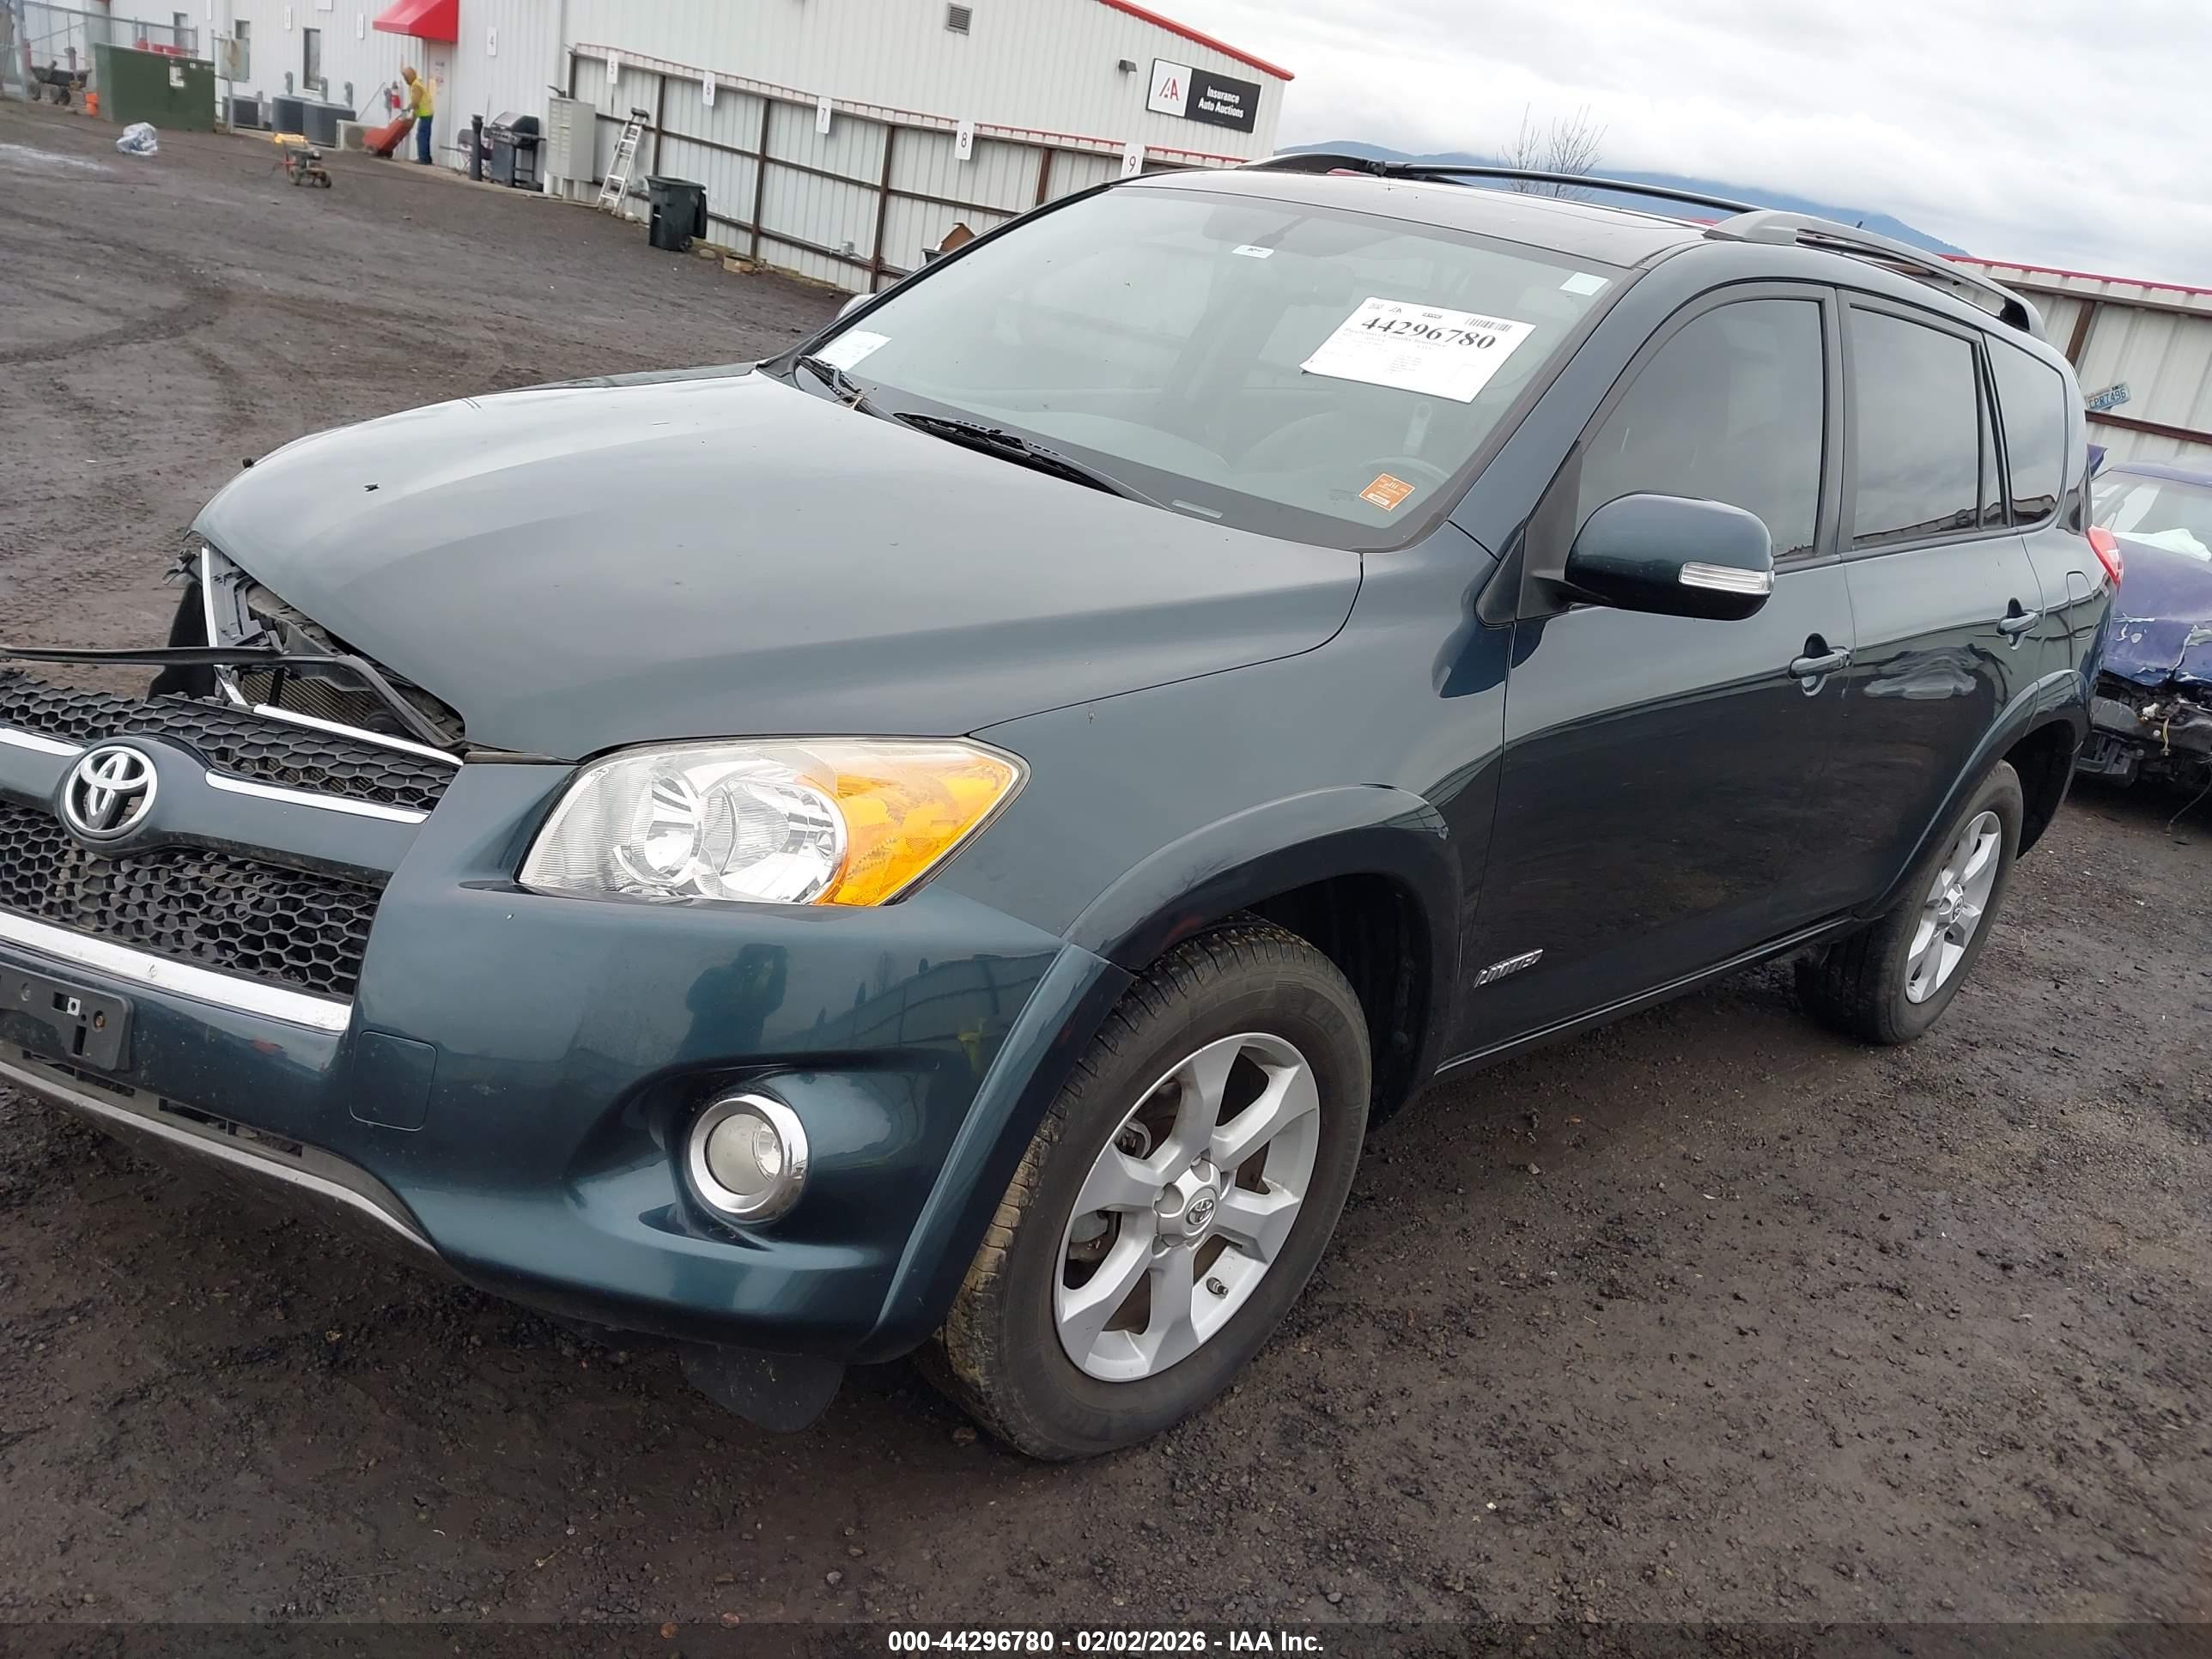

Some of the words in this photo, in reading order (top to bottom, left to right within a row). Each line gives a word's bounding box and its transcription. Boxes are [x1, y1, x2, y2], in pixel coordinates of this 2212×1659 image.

[706, 82, 712, 95] 6
[1206, 85, 1240, 104] Insurance
[821, 107, 827, 123] 7
[1198, 97, 1214, 112] Auto
[1214, 102, 1244, 118] Auctions
[960, 131, 968, 148] 8
[1129, 155, 1136, 173] 9
[1361, 317, 1496, 349] 44296780
[1474, 948, 1545, 988] LIMITED
